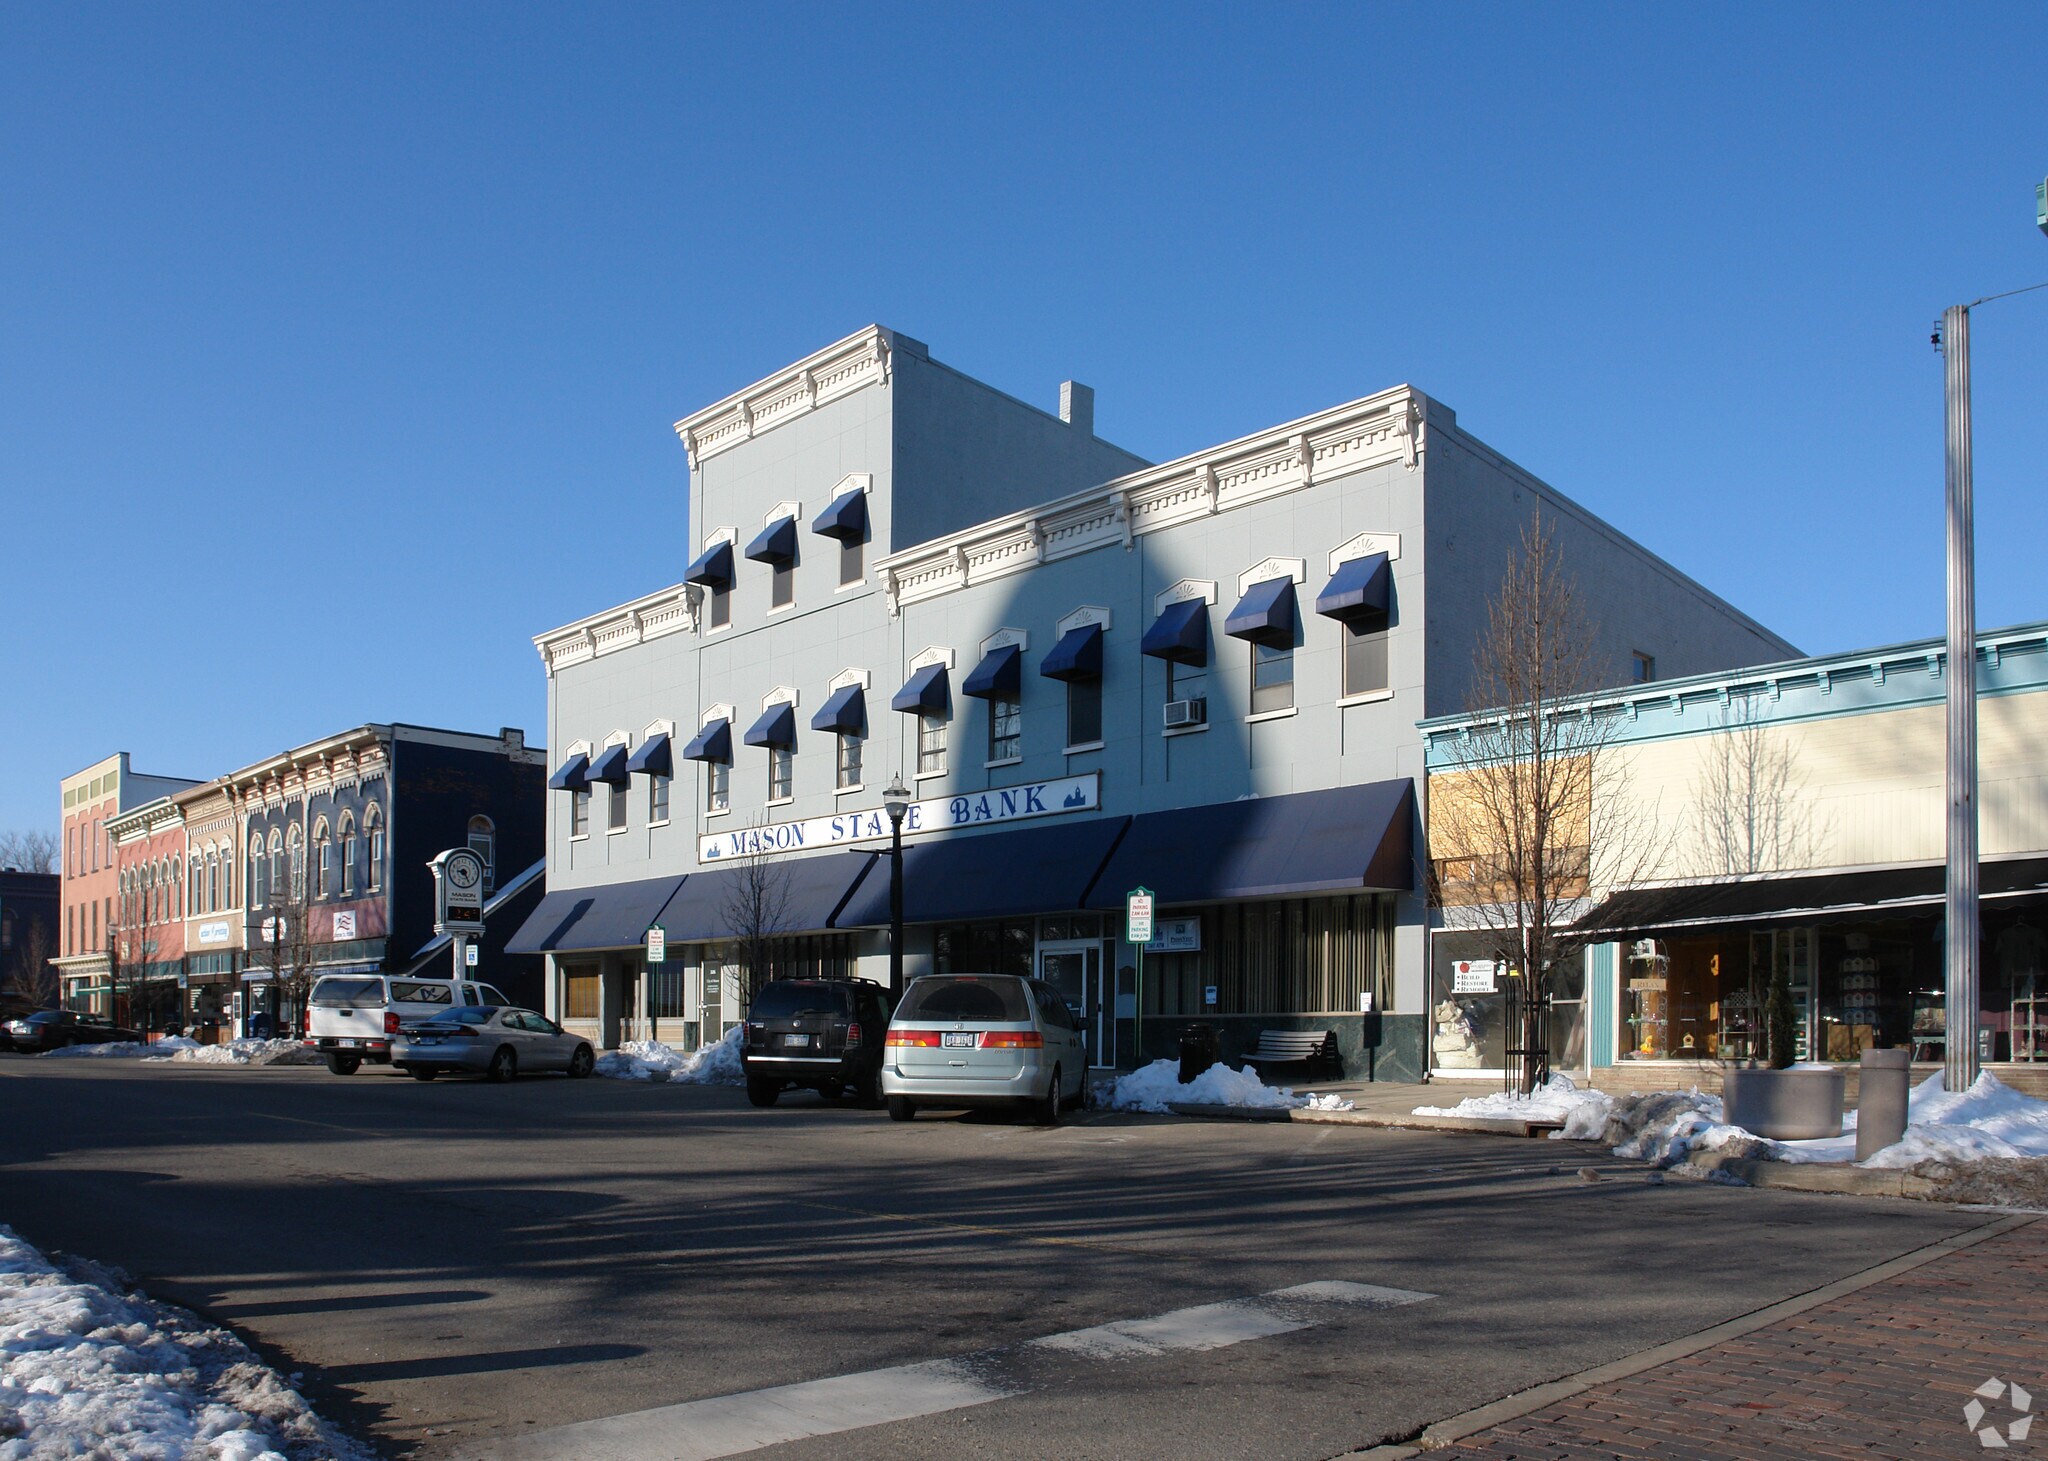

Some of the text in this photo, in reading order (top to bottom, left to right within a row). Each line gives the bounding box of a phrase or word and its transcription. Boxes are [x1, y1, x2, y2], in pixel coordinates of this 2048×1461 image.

[731, 785, 1048, 855] MASON STAE BANK
